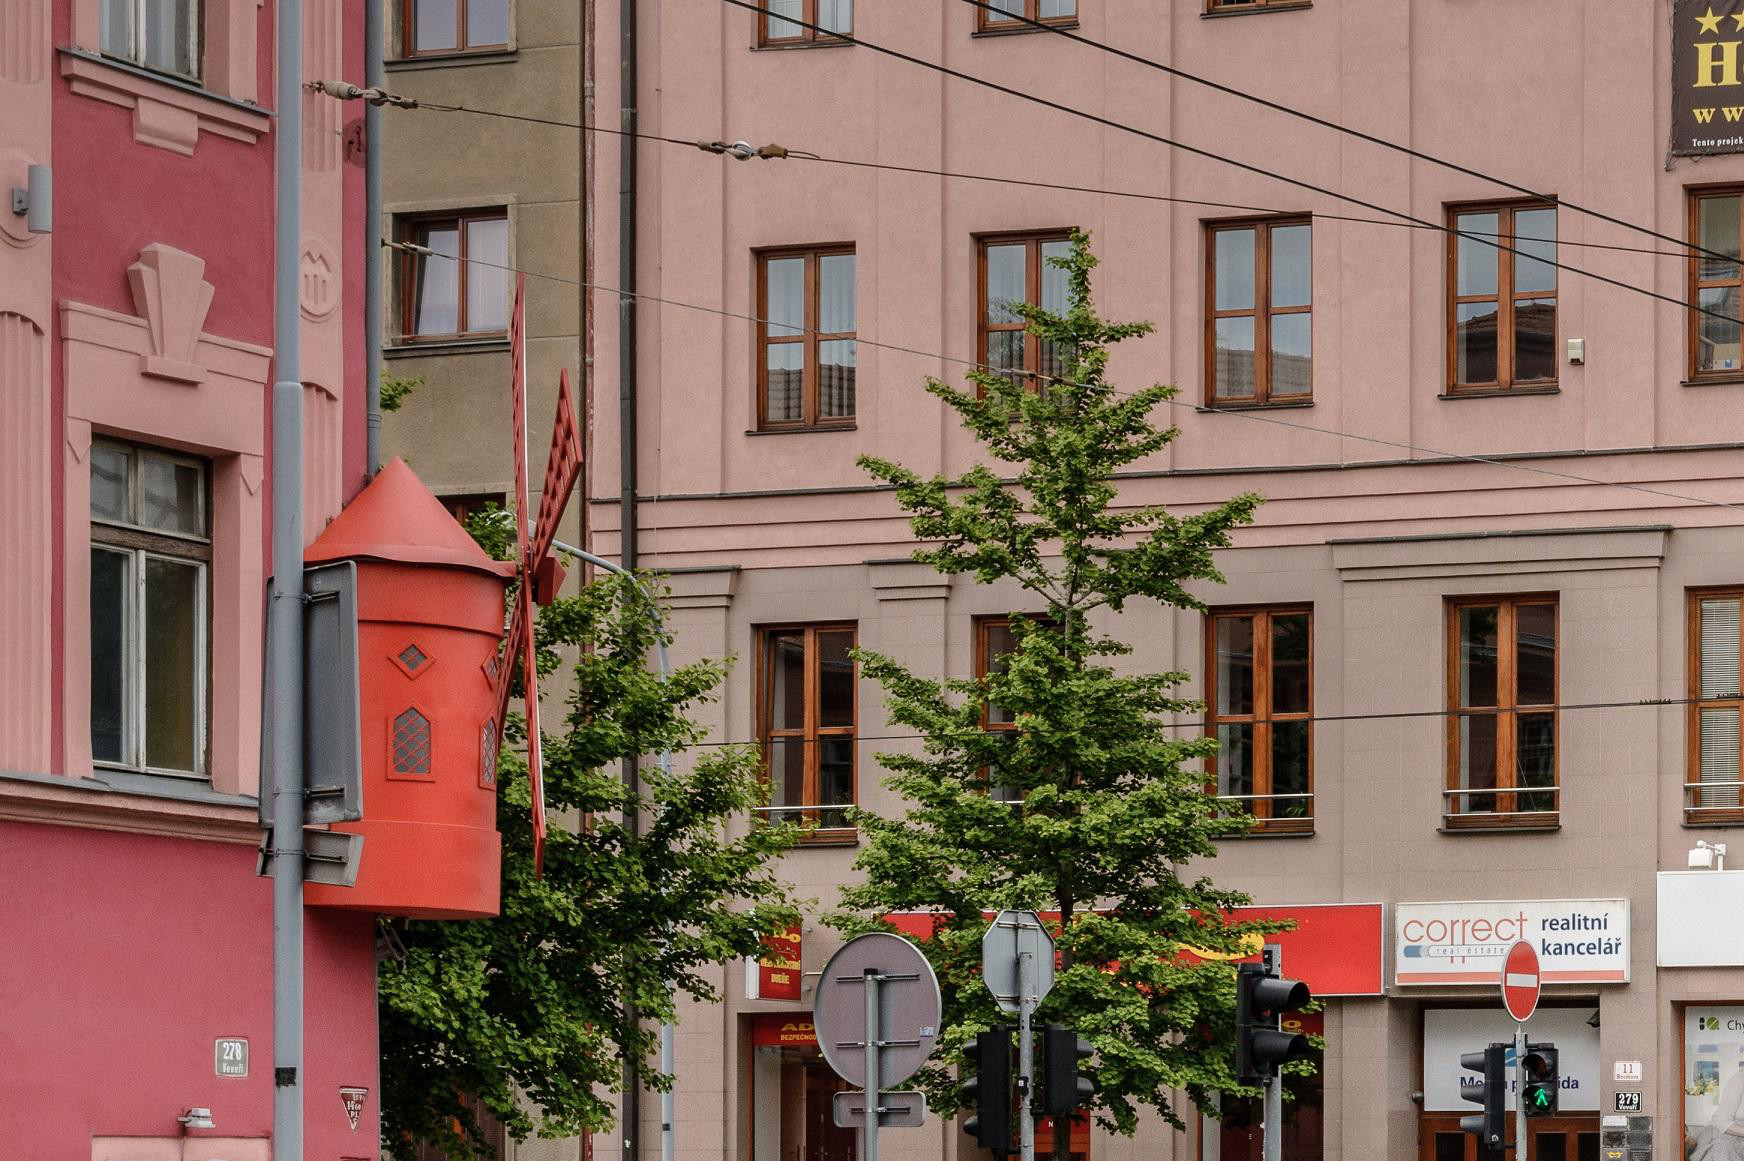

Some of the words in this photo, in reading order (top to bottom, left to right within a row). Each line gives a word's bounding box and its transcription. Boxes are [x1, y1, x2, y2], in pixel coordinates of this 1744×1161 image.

[1692, 138, 1715, 147] Tento
[1403, 911, 1528, 962] correct
[1541, 913, 1608, 931] realitní
[1436, 946, 1460, 955] real
[1467, 945, 1505, 955] estate
[1541, 938, 1622, 956] kancelář
[781, 1023, 815, 1031] AD
[780, 1033, 816, 1041] BEZPEČNOS
[222, 1042, 242, 1060] 278
[1623, 1063, 1633, 1074] 11
[1618, 1093, 1639, 1105] 279
